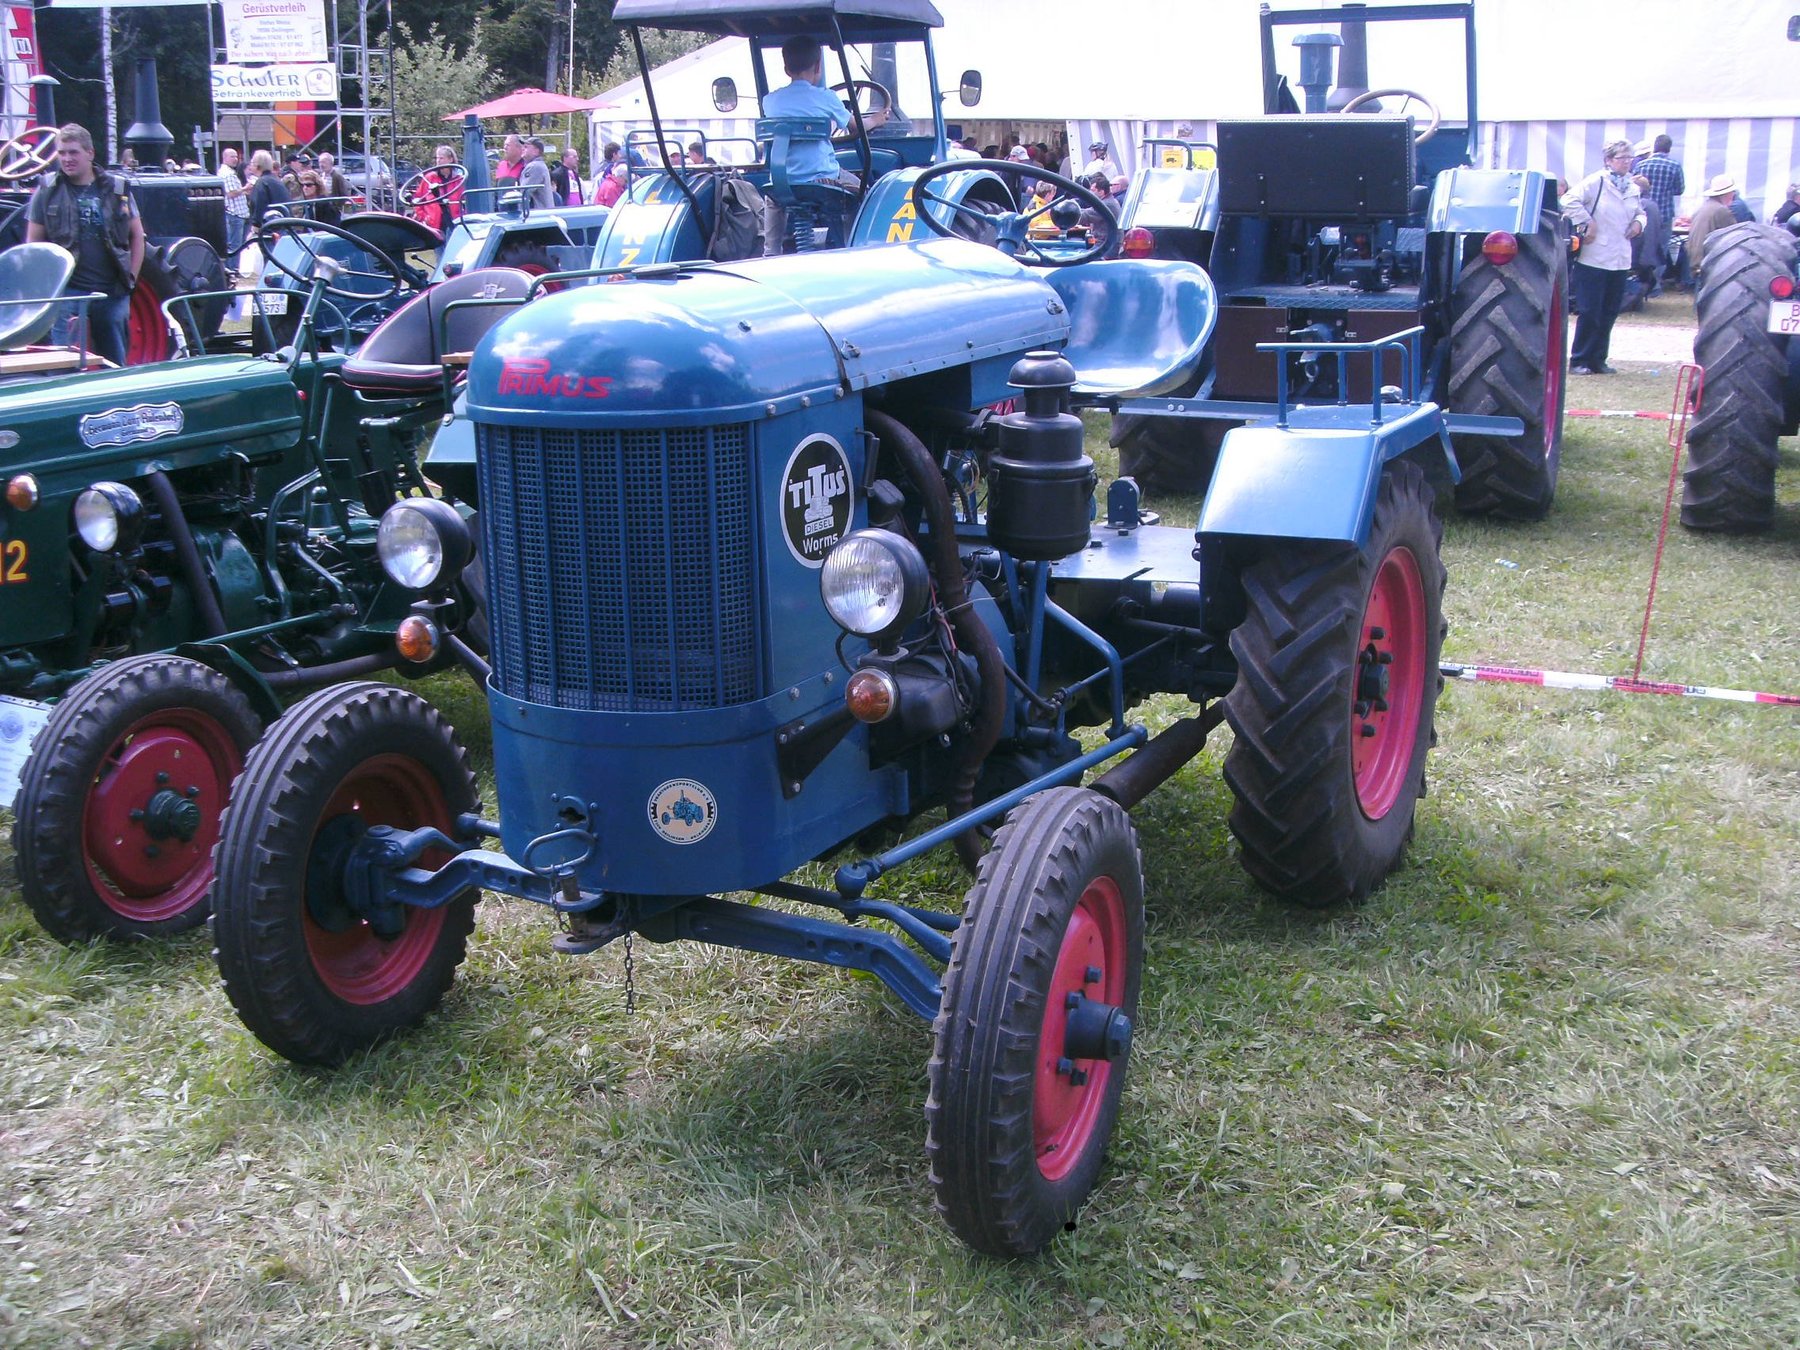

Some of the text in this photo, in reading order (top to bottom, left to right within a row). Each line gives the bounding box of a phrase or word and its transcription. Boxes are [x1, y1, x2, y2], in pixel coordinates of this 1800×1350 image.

[498, 356, 613, 399] PRIMUS
[805, 519, 833, 534] DIESEL
[802, 533, 839, 553] Worms
